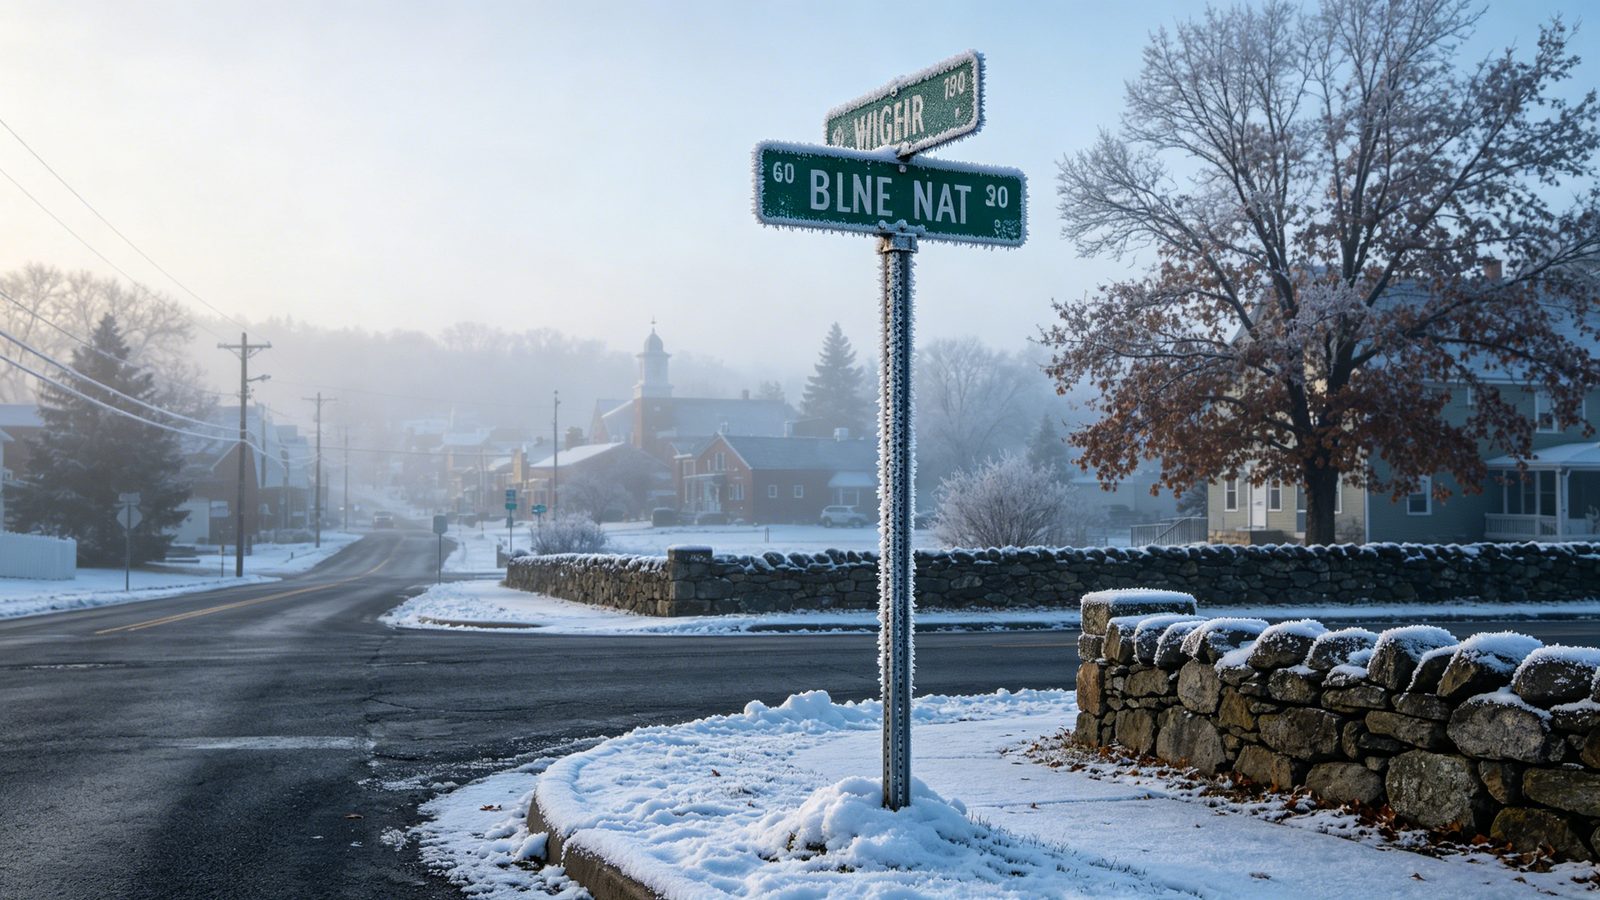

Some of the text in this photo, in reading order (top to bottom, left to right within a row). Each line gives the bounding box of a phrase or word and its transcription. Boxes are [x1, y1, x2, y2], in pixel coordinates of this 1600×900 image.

[772, 161, 795, 184] 60
[810, 169, 972, 225] BLNE NAT
